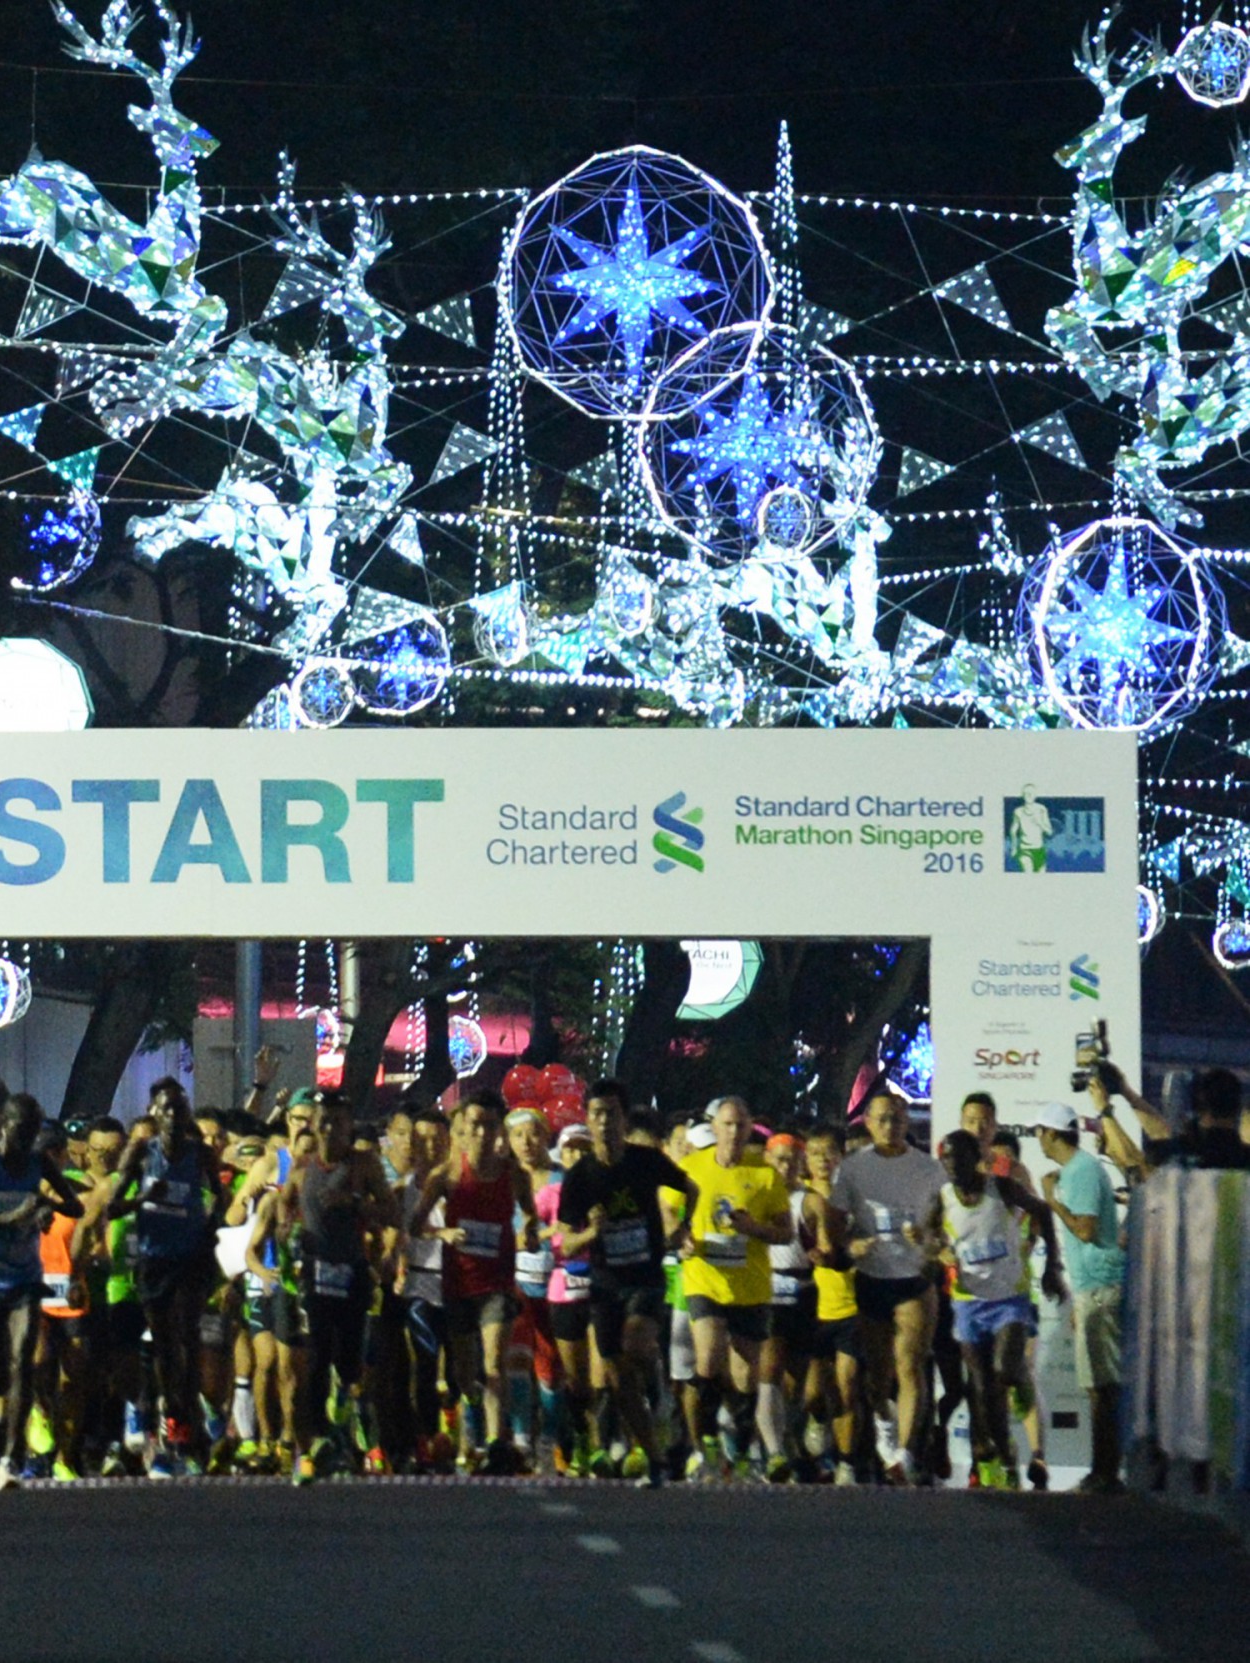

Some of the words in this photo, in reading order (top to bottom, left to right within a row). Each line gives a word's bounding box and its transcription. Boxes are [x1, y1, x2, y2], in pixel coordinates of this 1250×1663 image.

[498, 803, 638, 831] Standard
[734, 794, 851, 818] Standard
[855, 794, 984, 818] Chartered
[734, 823, 853, 846] Marathon
[859, 823, 985, 851] Singapore
[485, 838, 639, 866] Chartered
[923, 851, 985, 874] 2016
[978, 959, 1062, 977] Standard
[970, 979, 1062, 998] Chartered
[973, 1048, 1042, 1070] Sport
